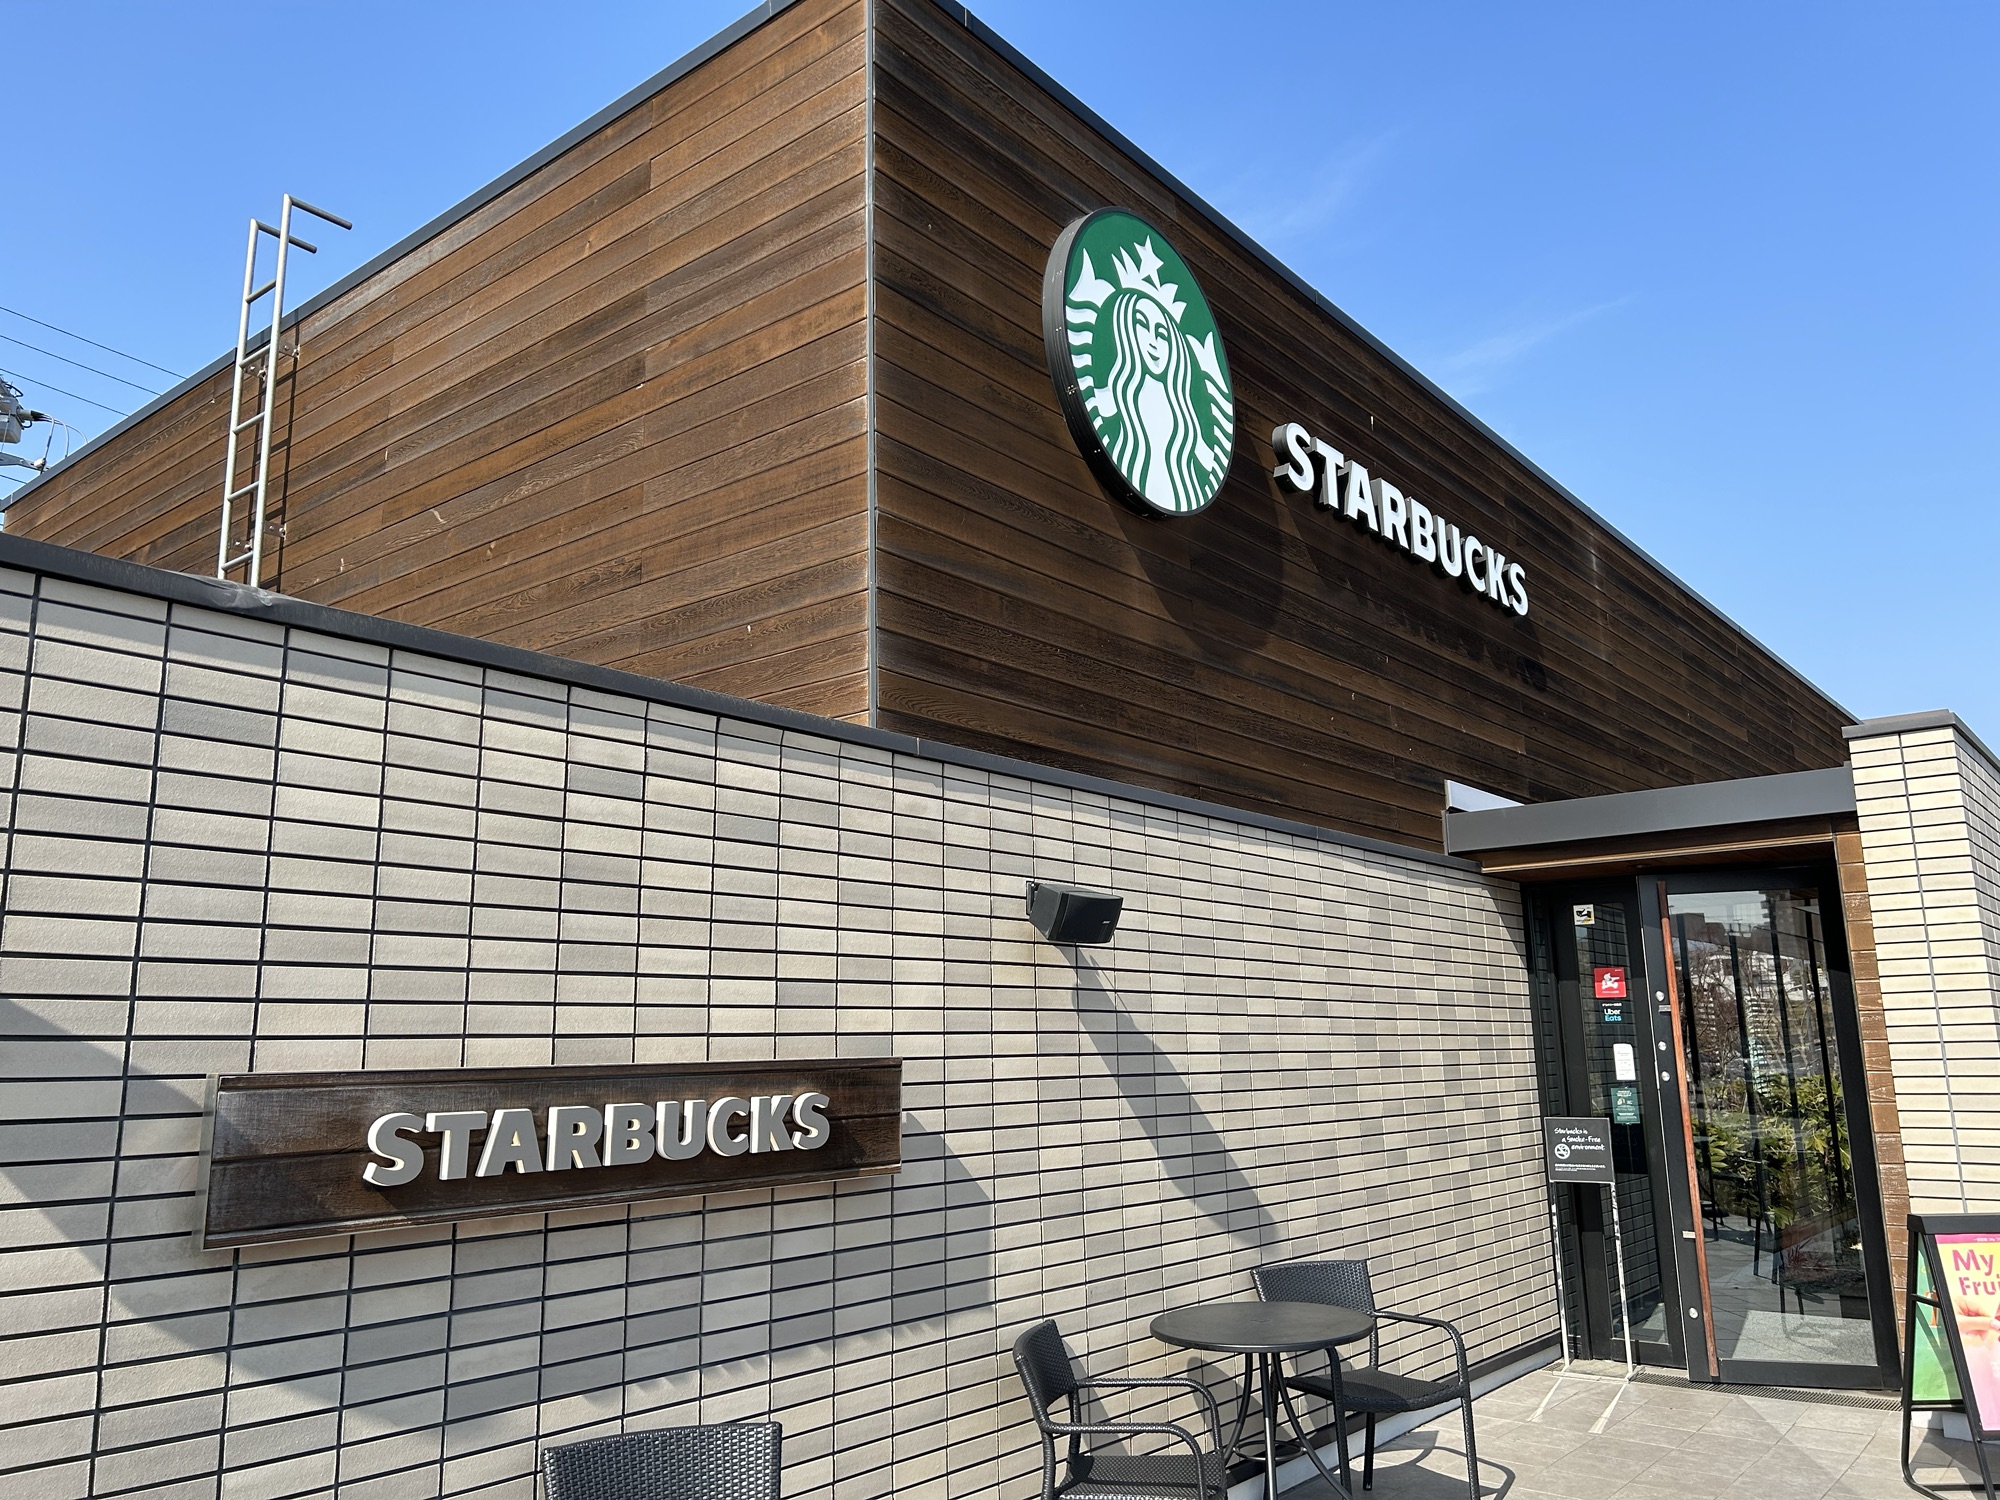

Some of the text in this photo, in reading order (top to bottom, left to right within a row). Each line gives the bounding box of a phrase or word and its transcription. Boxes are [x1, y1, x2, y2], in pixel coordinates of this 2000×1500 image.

[1272, 422, 1529, 616] STARBUCKS
[363, 1091, 831, 1187] STARBUCKS
[1952, 1249, 1994, 1276] My
